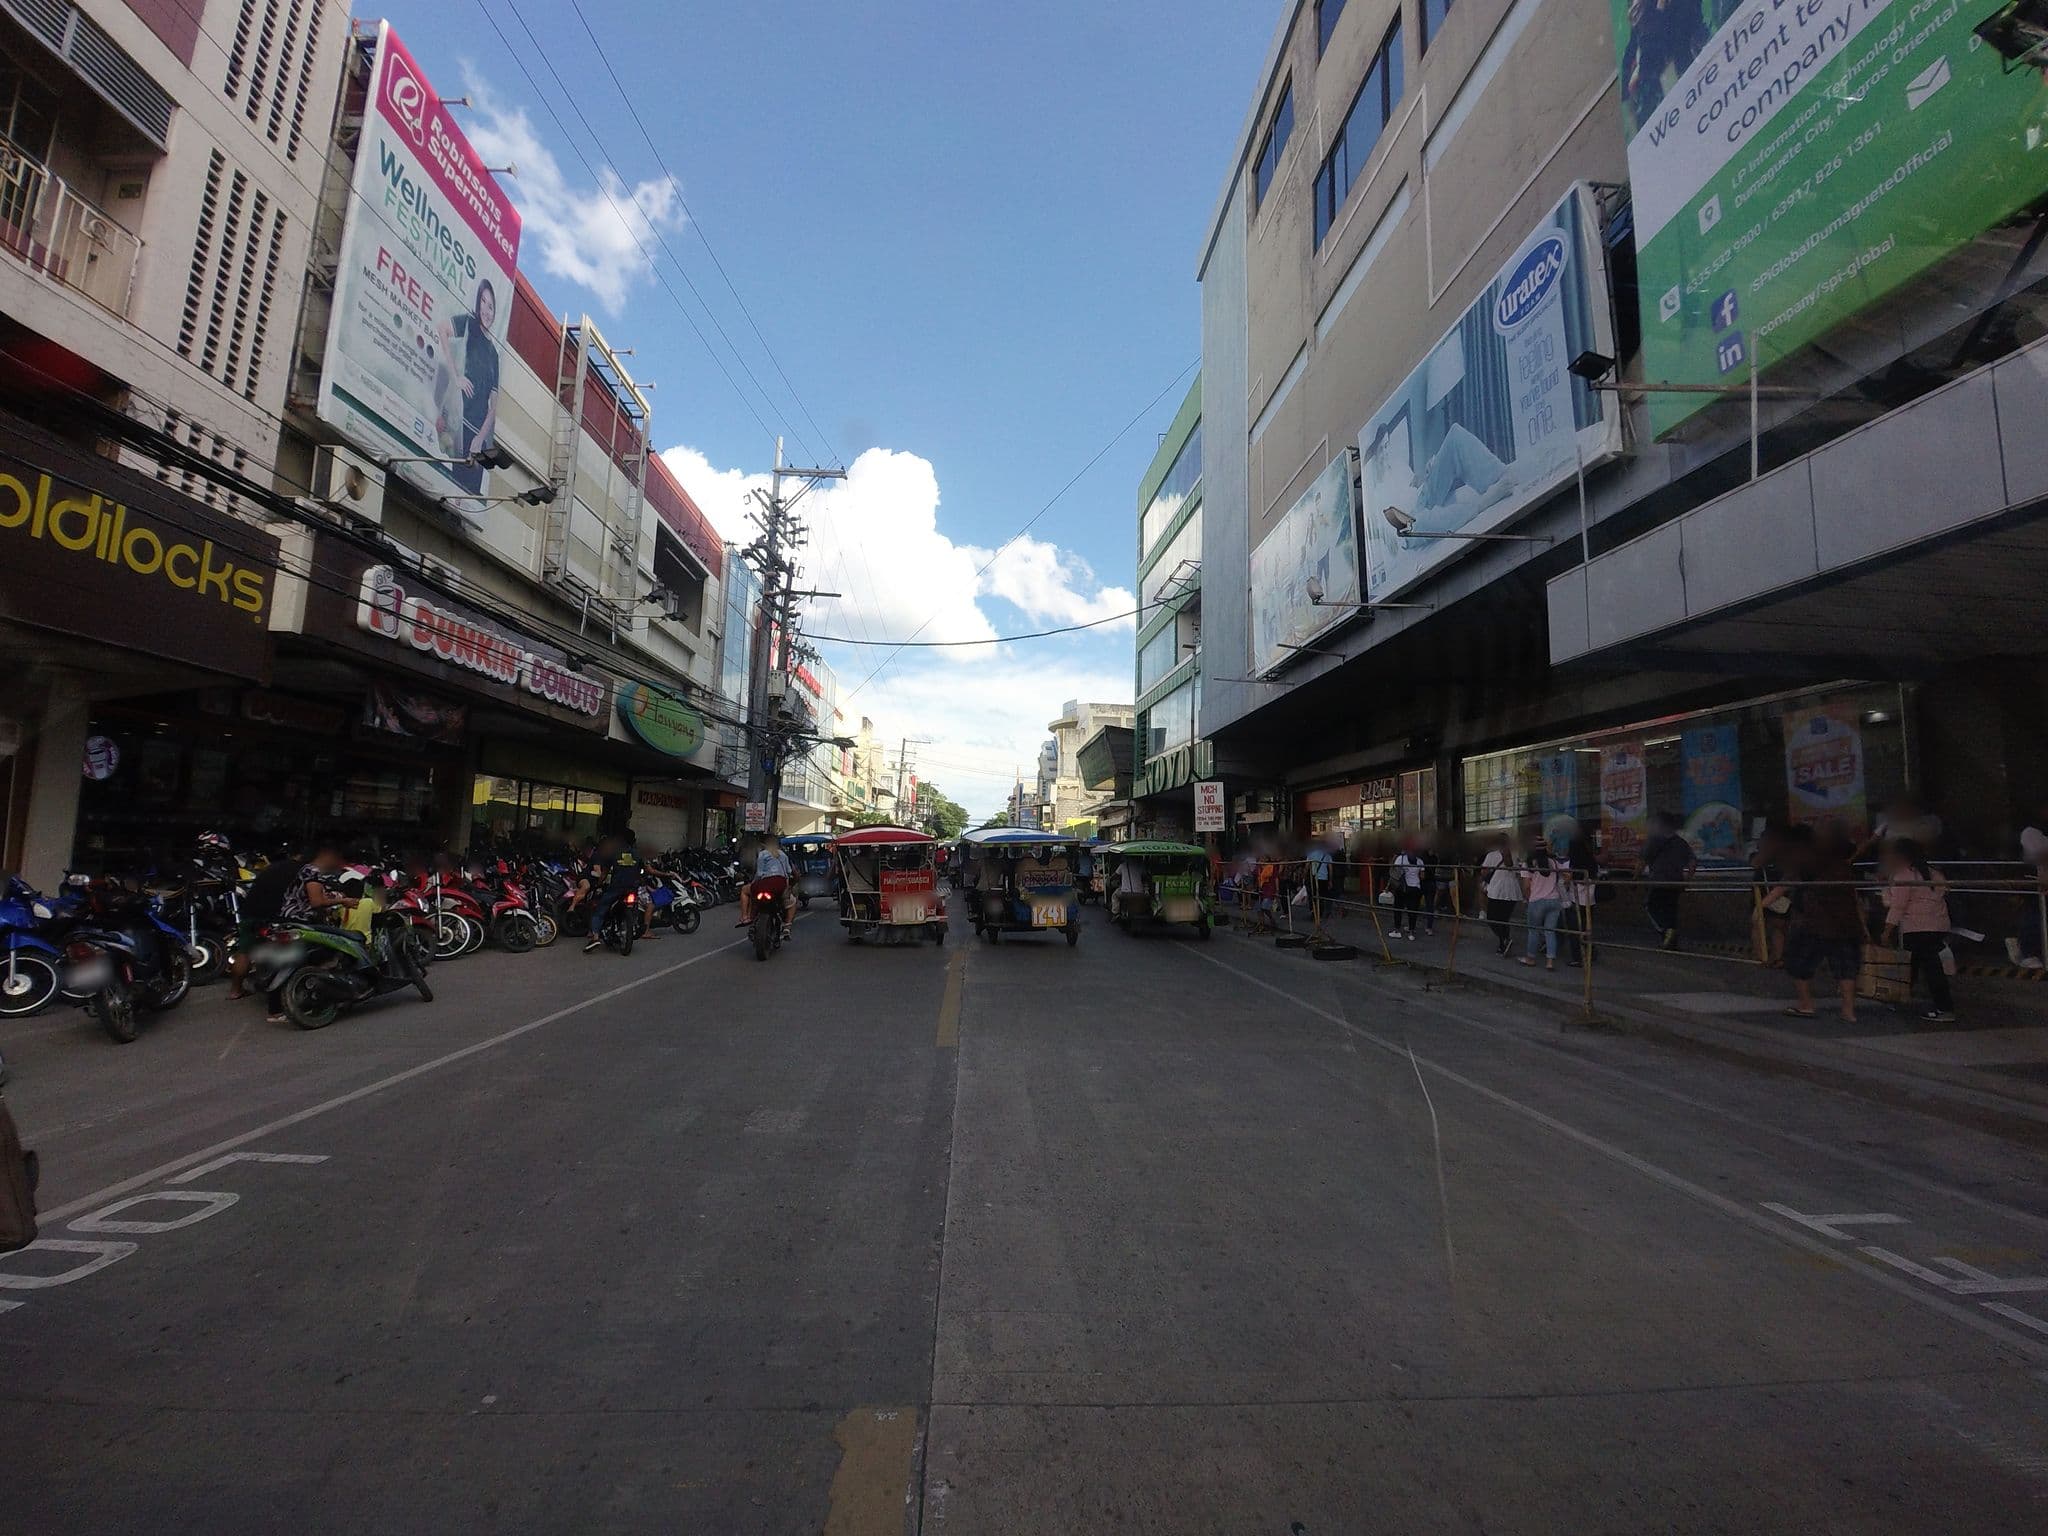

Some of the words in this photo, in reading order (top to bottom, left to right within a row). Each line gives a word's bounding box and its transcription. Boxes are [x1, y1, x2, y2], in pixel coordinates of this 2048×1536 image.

[1649, 107, 1680, 147] We
[1685, 63, 1718, 110] are
[1725, 10, 1765, 63] the
[1697, 23, 1790, 134] content
[1727, 3, 1852, 143] company
[1735, 142, 1802, 208] Dumaguete
[1837, 64, 1889, 116] Negros
[1893, 3, 1958, 64] Oriental
[1823, 20, 1906, 101] Technology
[380, 138, 476, 280] Wellness
[428, 136, 515, 260] Supermarket
[430, 115, 502, 223] Robinsons
[1815, 154, 1842, 185] 826
[377, 246, 434, 321] FREE
[385, 185, 466, 296] FESTIVAL
[363, 266, 388, 296] MESH
[390, 292, 423, 327] MARKET
[424, 324, 440, 345] BAG
[412, 601, 523, 682] DUNKIN'
[530, 657, 601, 713] DONUTS
[1200, 785, 1218, 794] MCH
[1204, 795, 1215, 804] NO
[1606, 782, 1642, 802] SALE
